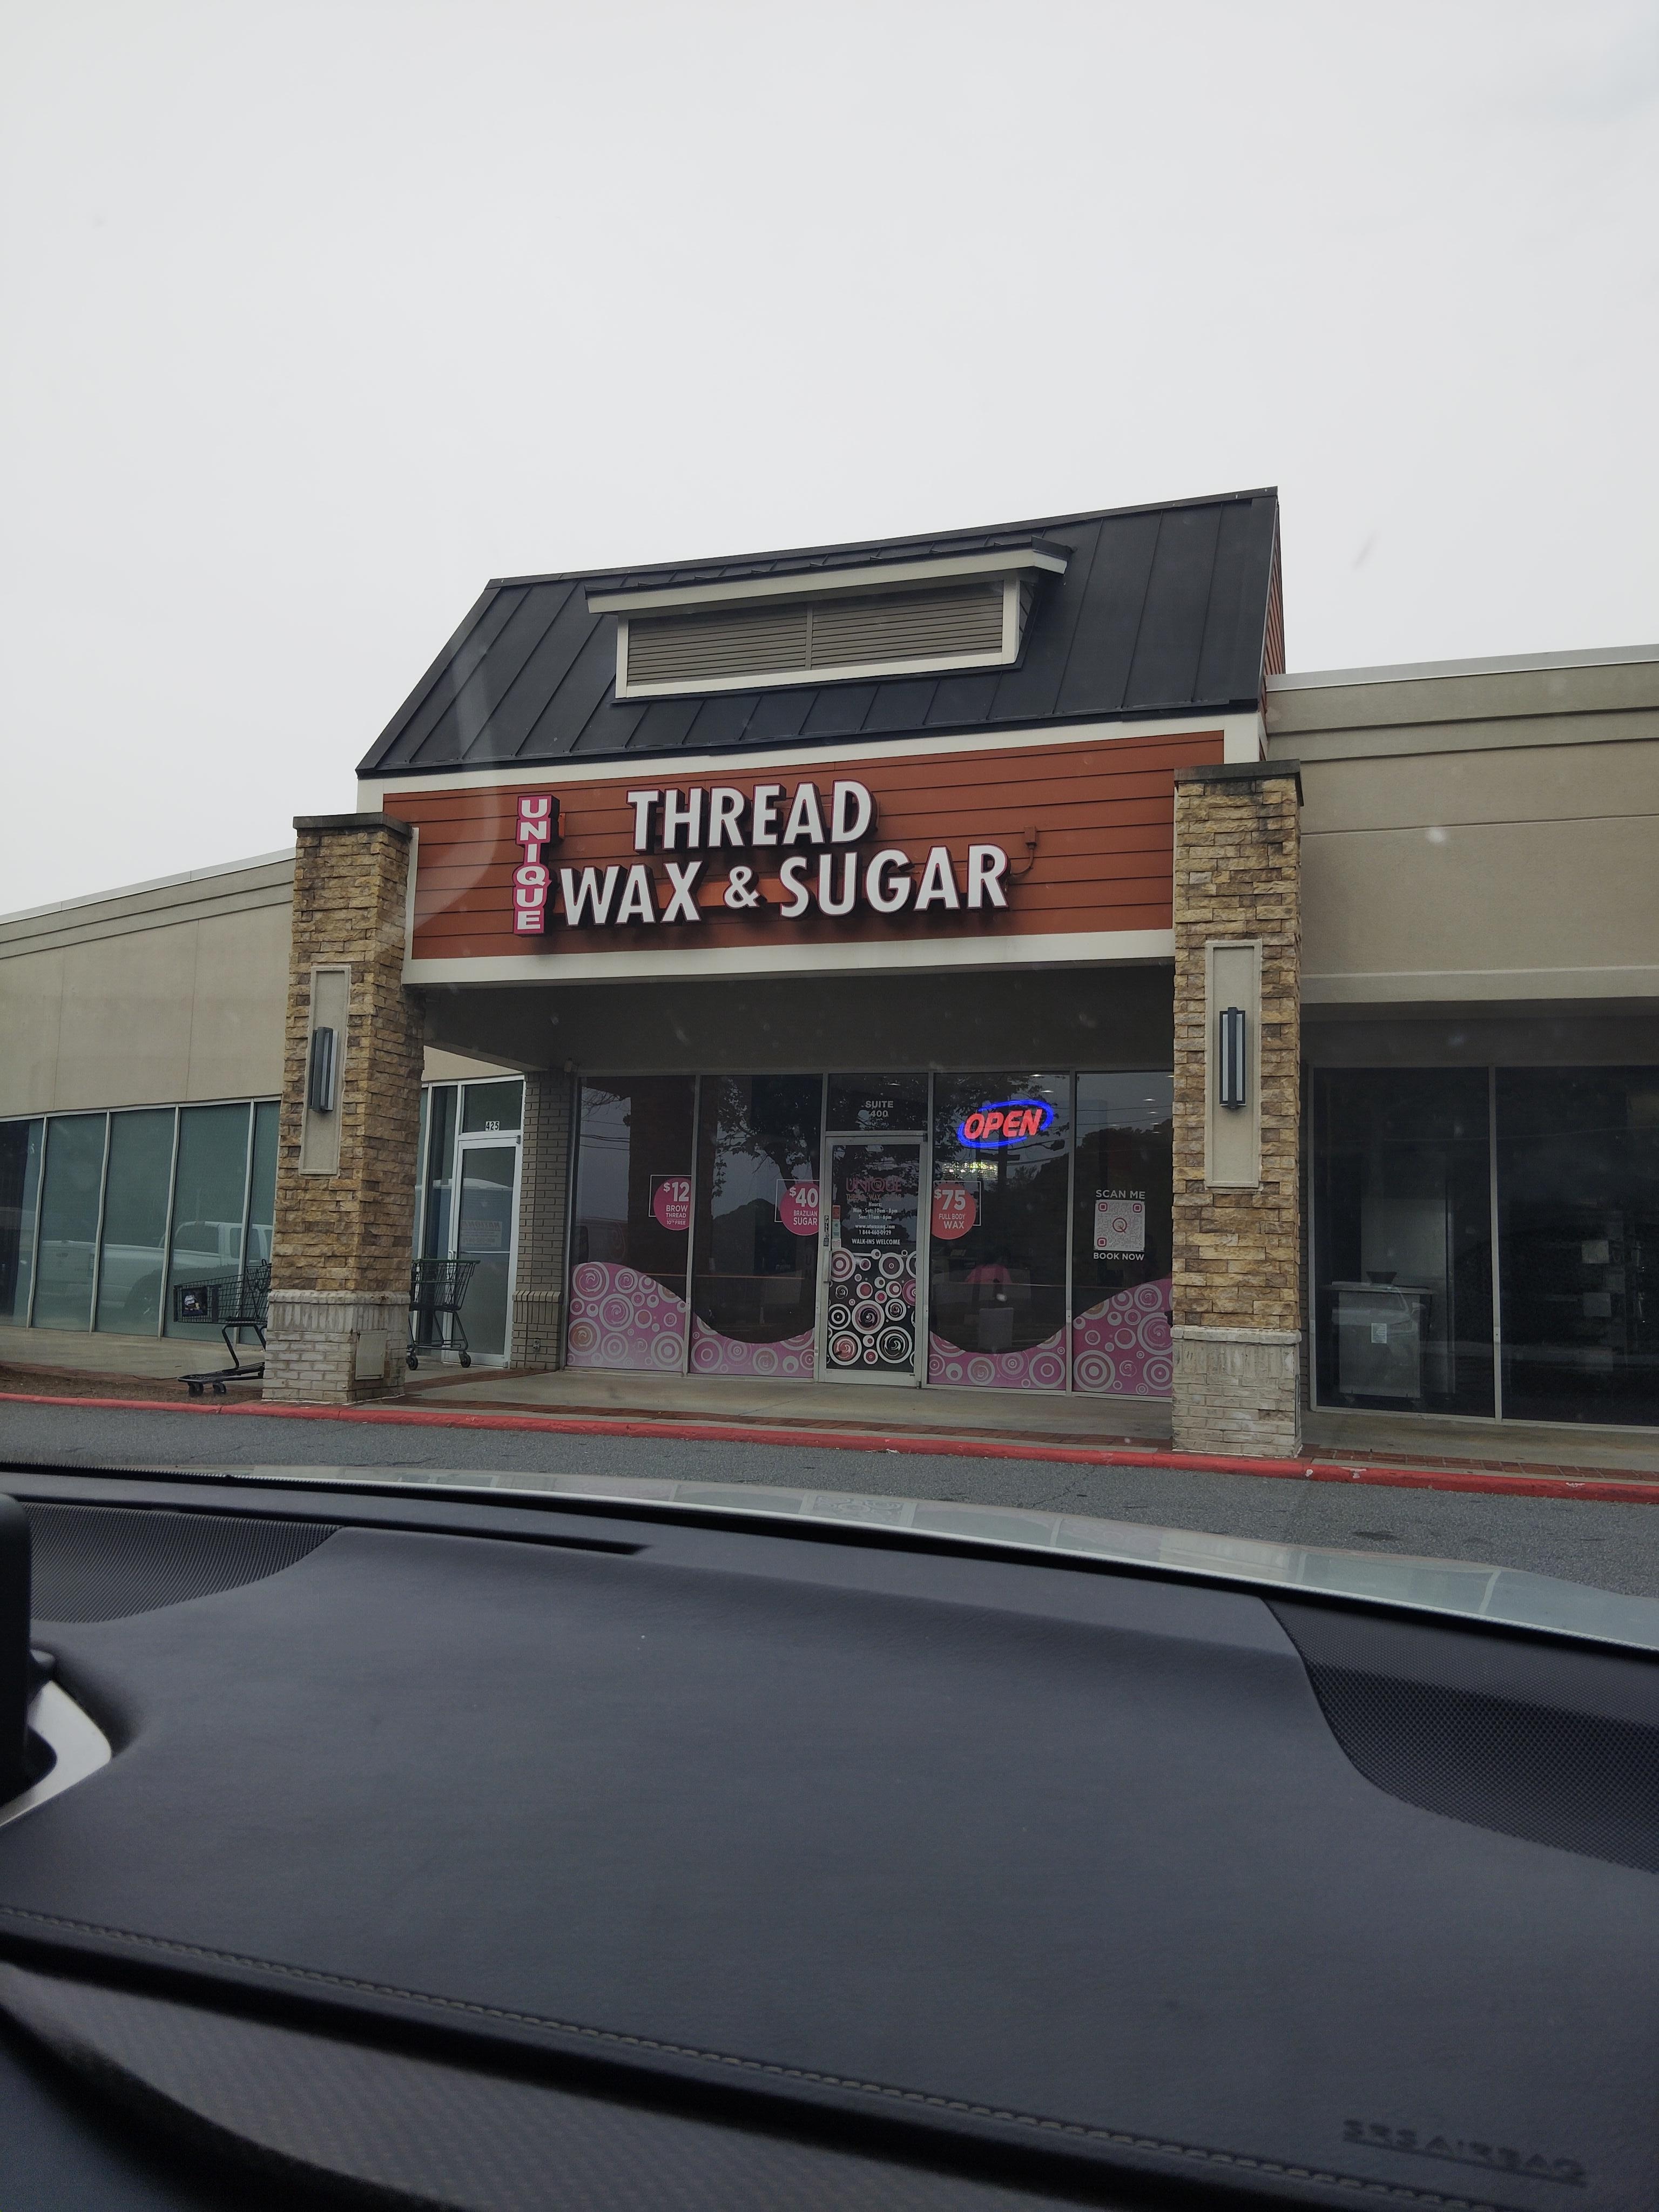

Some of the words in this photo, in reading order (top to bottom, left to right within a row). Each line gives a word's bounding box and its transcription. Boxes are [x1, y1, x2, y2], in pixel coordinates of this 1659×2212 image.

[627, 780, 872, 852] THREAD
[516, 799, 548, 930] UNIQUE
[560, 861, 702, 926] WAX
[724, 865, 759, 909] &
[779, 844, 1009, 919] SUGAR
[486, 1122, 499, 1130] 425
[964, 1109, 1043, 1140] OPEN
[663, 1182, 690, 1202] $12
[846, 1177, 902, 1192] UNIQUE
[1096, 1190, 1126, 1198] SCAN
[1130, 1190, 1145, 1199] ME
[789, 1186, 819, 1208] $40
[934, 1189, 966, 1210] $75
[793, 1217, 818, 1225] SUGAR
